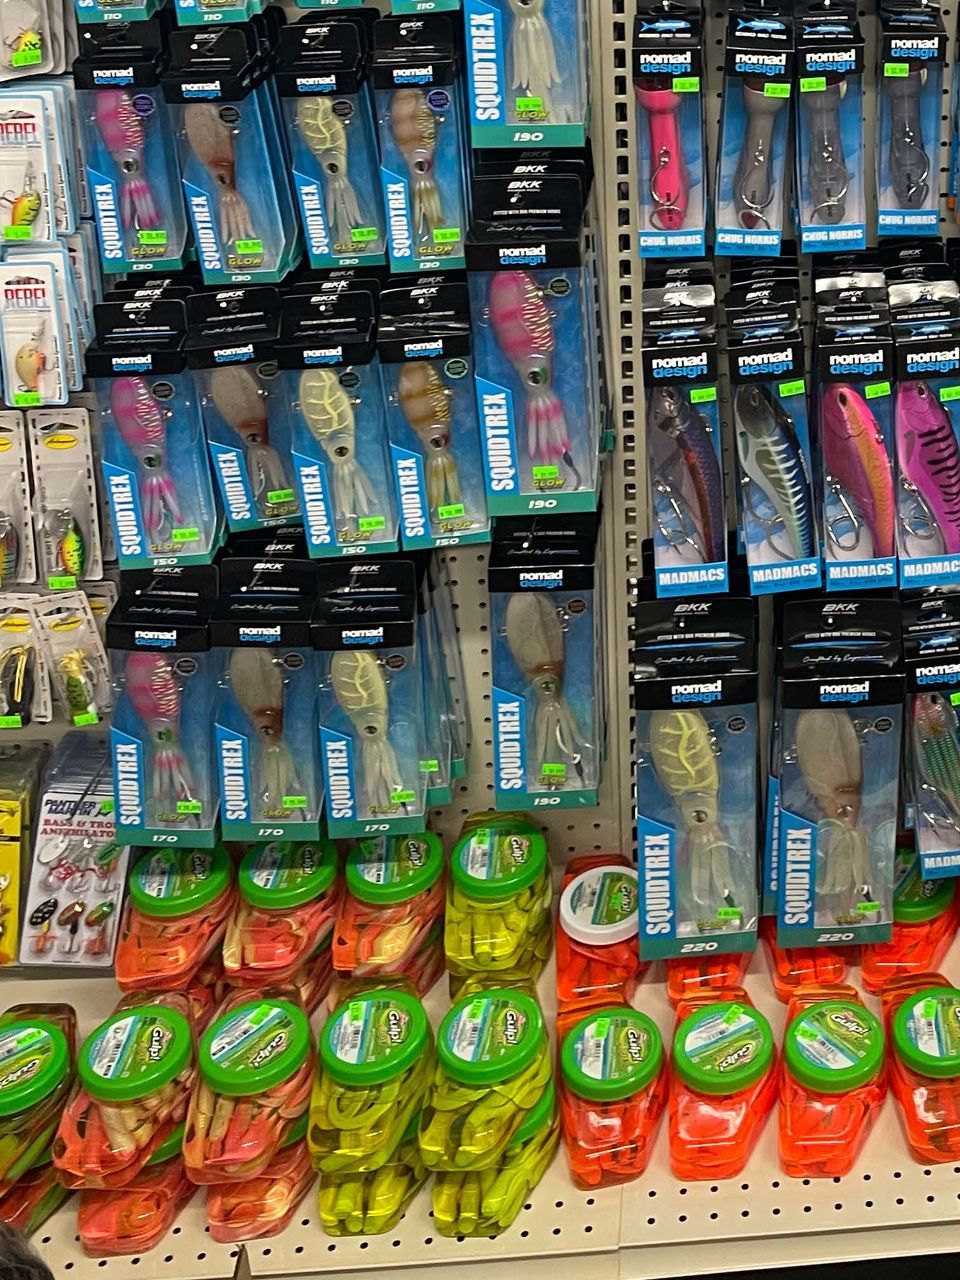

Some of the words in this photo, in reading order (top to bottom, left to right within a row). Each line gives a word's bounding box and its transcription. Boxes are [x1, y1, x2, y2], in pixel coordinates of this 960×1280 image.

[417, 2, 435, 10] 110
[640, 52, 691, 63] nomad
[93, 67, 133, 77] nomad
[475, 13, 499, 121] SQUIDTREX
[640, 63, 691, 75] design
[95, 76, 134, 86] design
[513, 132, 543, 141] 190
[94, 183, 122, 259] SQUIDTREX
[640, 234, 664, 246] CHUG
[666, 234, 702, 245] NORRIS
[718, 233, 742, 244] CHUG
[744, 234, 779, 245] NORRIS
[803, 231, 827, 241] CHUG
[829, 229, 863, 240] NORRIS
[499, 245, 545, 256] nomad
[502, 255, 546, 265] design
[5, 289, 50, 308] REBEL
[112, 355, 151, 364] nomad
[652, 352, 707, 368] nomad
[907, 347, 959, 363] nomad
[113, 363, 152, 372] design
[653, 365, 707, 378] design
[907, 359, 959, 373] design
[482, 393, 513, 491] SQUIDTREX
[299, 465, 331, 544] SQUIDTREX
[528, 500, 558, 509] 190
[109, 474, 143, 555] SQUIDTREX
[153, 558, 178, 566] 150
[520, 570, 562, 580] nomad
[659, 567, 725, 586] MADMACS
[753, 562, 817, 582] MADMACS
[829, 562, 894, 580] MADMACS
[520, 579, 562, 588] design
[240, 626, 280, 635] nomad
[240, 634, 279, 643] design
[116, 743, 141, 825] SQUIDTREX
[77, 820, 87, 828] &
[40, 828, 115, 837] ANNIHILATO
[785, 828, 811, 925] SQUIDTREX
[644, 833, 670, 935] SQUIDTREX
[817, 933, 854, 942] 220
[681, 942, 718, 952] 220
